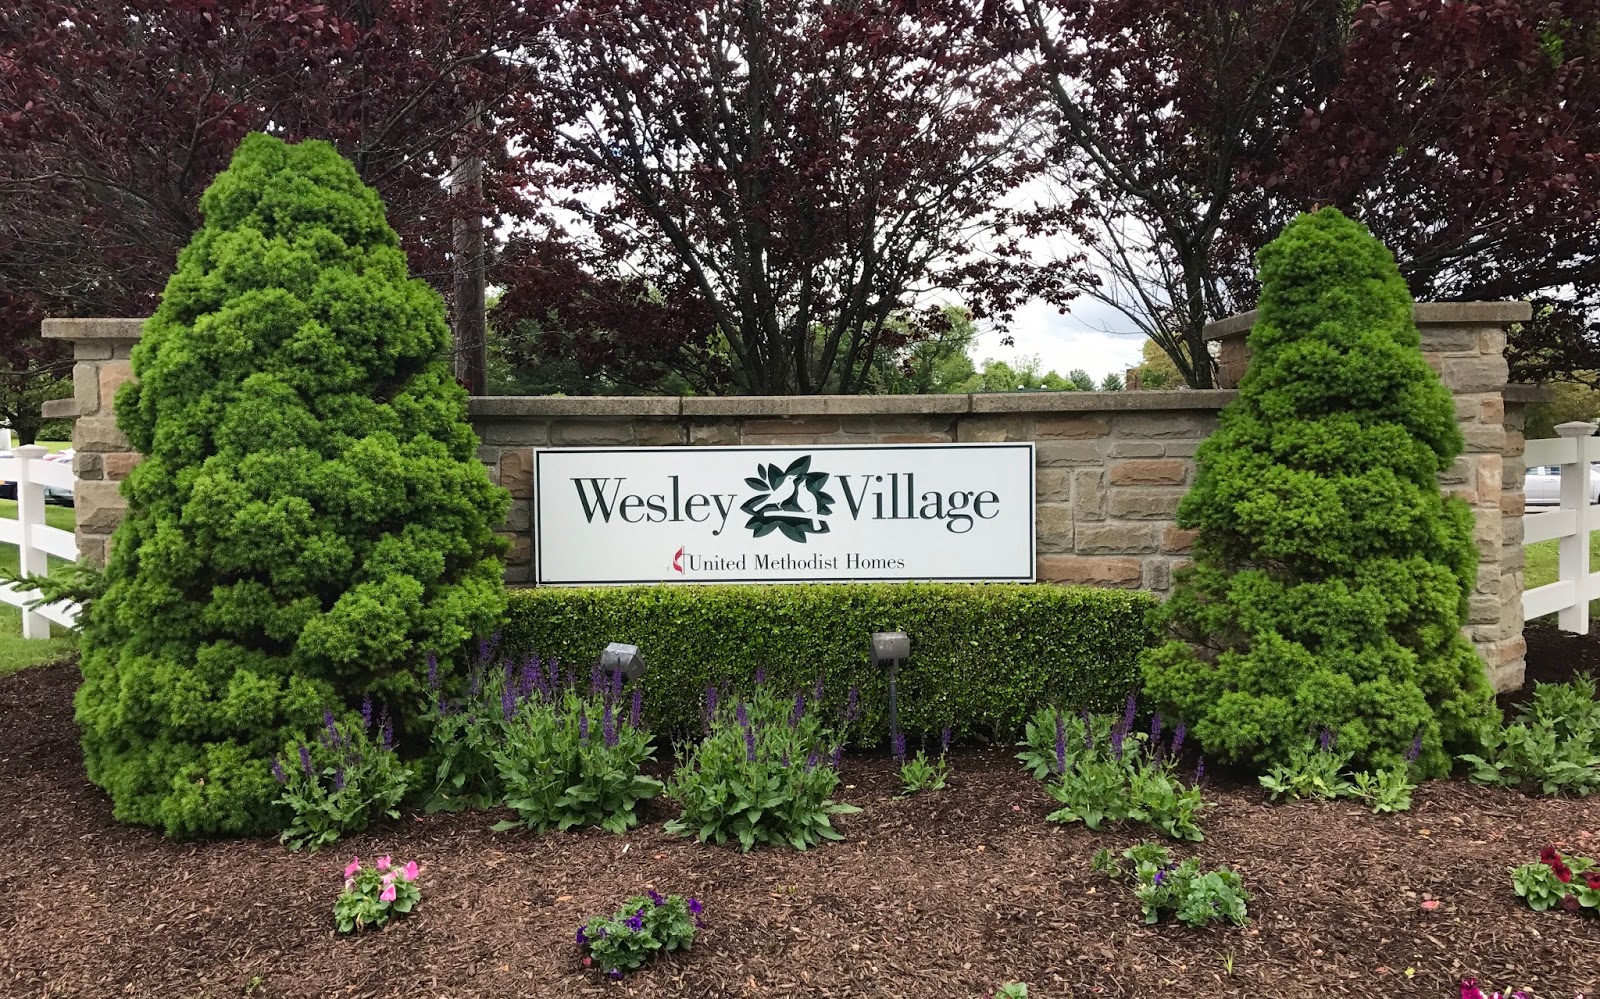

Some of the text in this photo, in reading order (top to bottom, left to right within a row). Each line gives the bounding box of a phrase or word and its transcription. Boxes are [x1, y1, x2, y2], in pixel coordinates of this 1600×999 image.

[570, 472, 1000, 536] Wesley Village
[689, 553, 906, 571] United Methodist Homes
